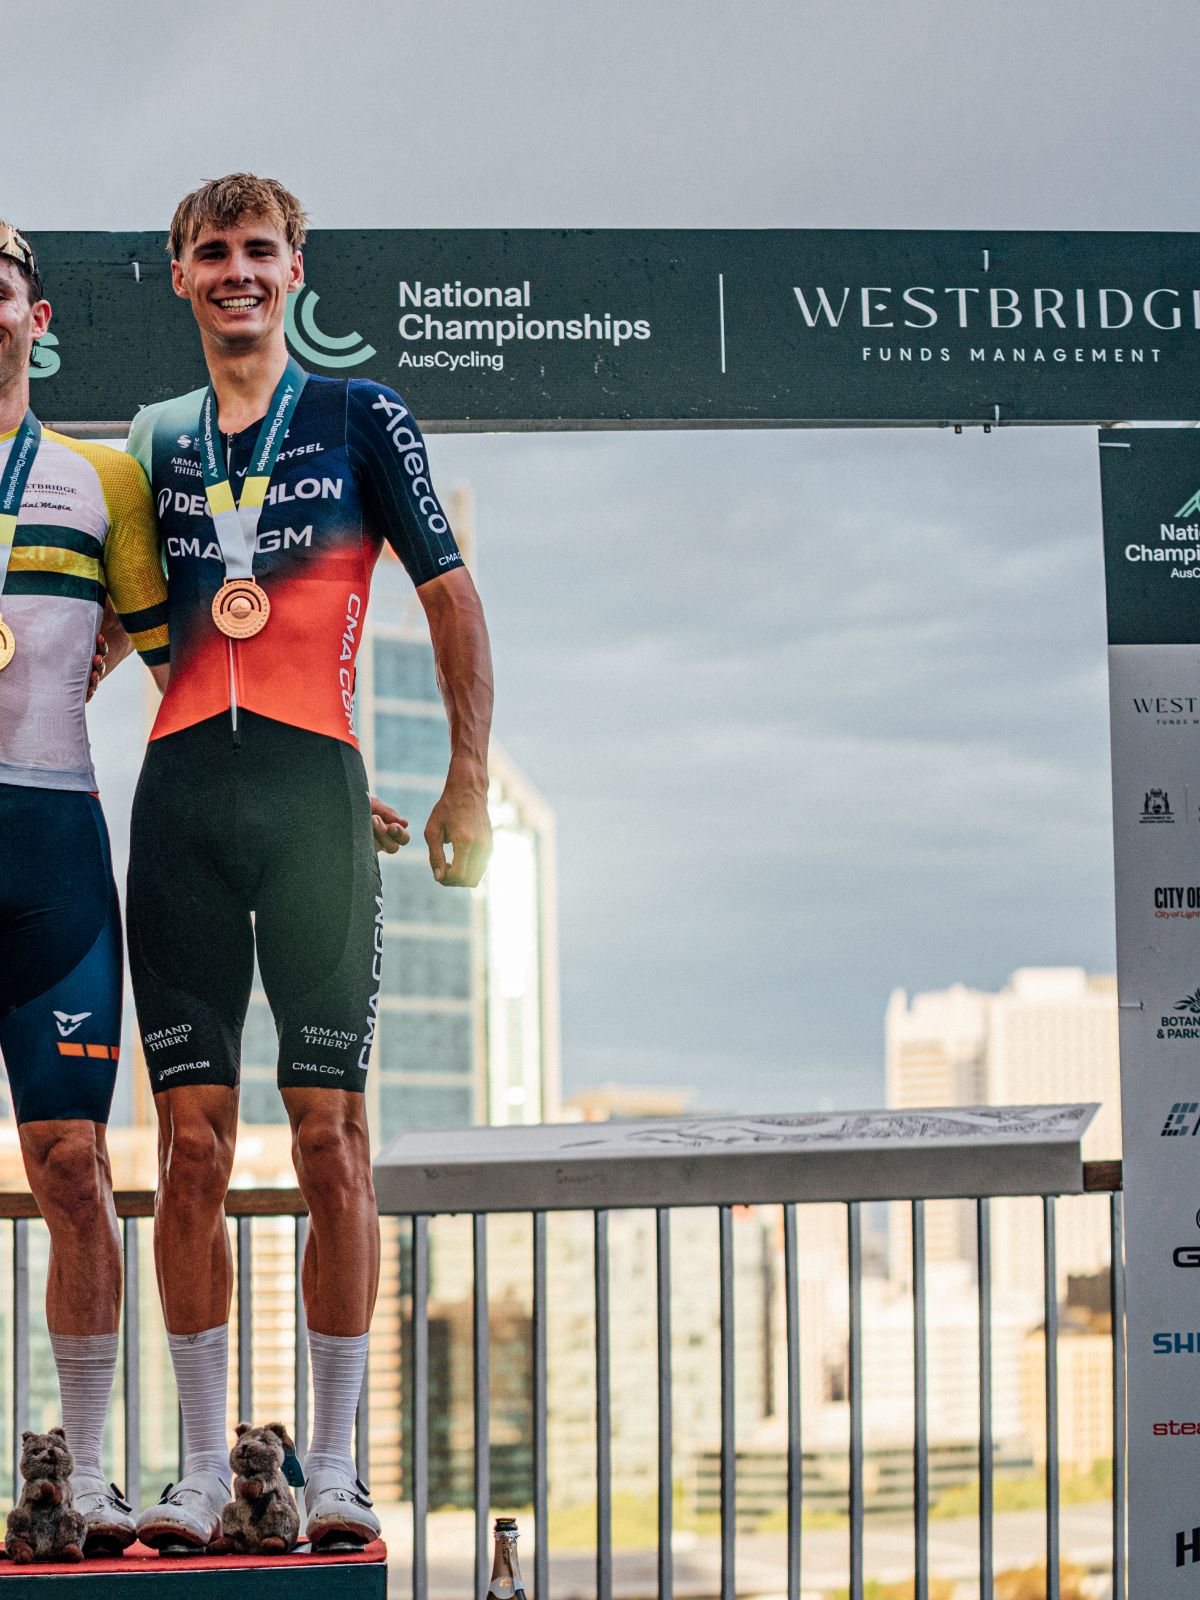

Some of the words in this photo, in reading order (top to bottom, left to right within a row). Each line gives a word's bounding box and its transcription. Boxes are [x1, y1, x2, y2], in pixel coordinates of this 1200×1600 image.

[400, 281, 531, 308] National
[399, 313, 651, 346] Championships
[398, 351, 504, 371] AusCycling
[862, 347, 951, 362] FUNDS
[970, 348, 1162, 363] MANAGEMENT
[275, 393, 293, 418] National
[19, 436, 34, 460] National
[205, 440, 216, 469] National
[256, 418, 283, 472] Championships
[275, 442, 325, 462] RYSEL
[372, 394, 448, 534] Adecco
[3, 458, 26, 510] Championships
[1160, 523, 1200, 541] Nati
[167, 536, 224, 564] CMA
[254, 525, 313, 554] GM
[339, 593, 361, 662] CMA
[1154, 887, 1184, 909] CITY
[144, 1023, 193, 1045] ARMAND
[149, 1034, 189, 1052] THIERY
[300, 1025, 358, 1042] ARMAND
[304, 1035, 351, 1050] THIERY
[1156, 1029, 1165, 1039] &
[1167, 1028, 1200, 1039] PARK
[163, 1060, 211, 1077] DECATHLON
[292, 1062, 318, 1072] CMA
[320, 1065, 345, 1077] CGM
